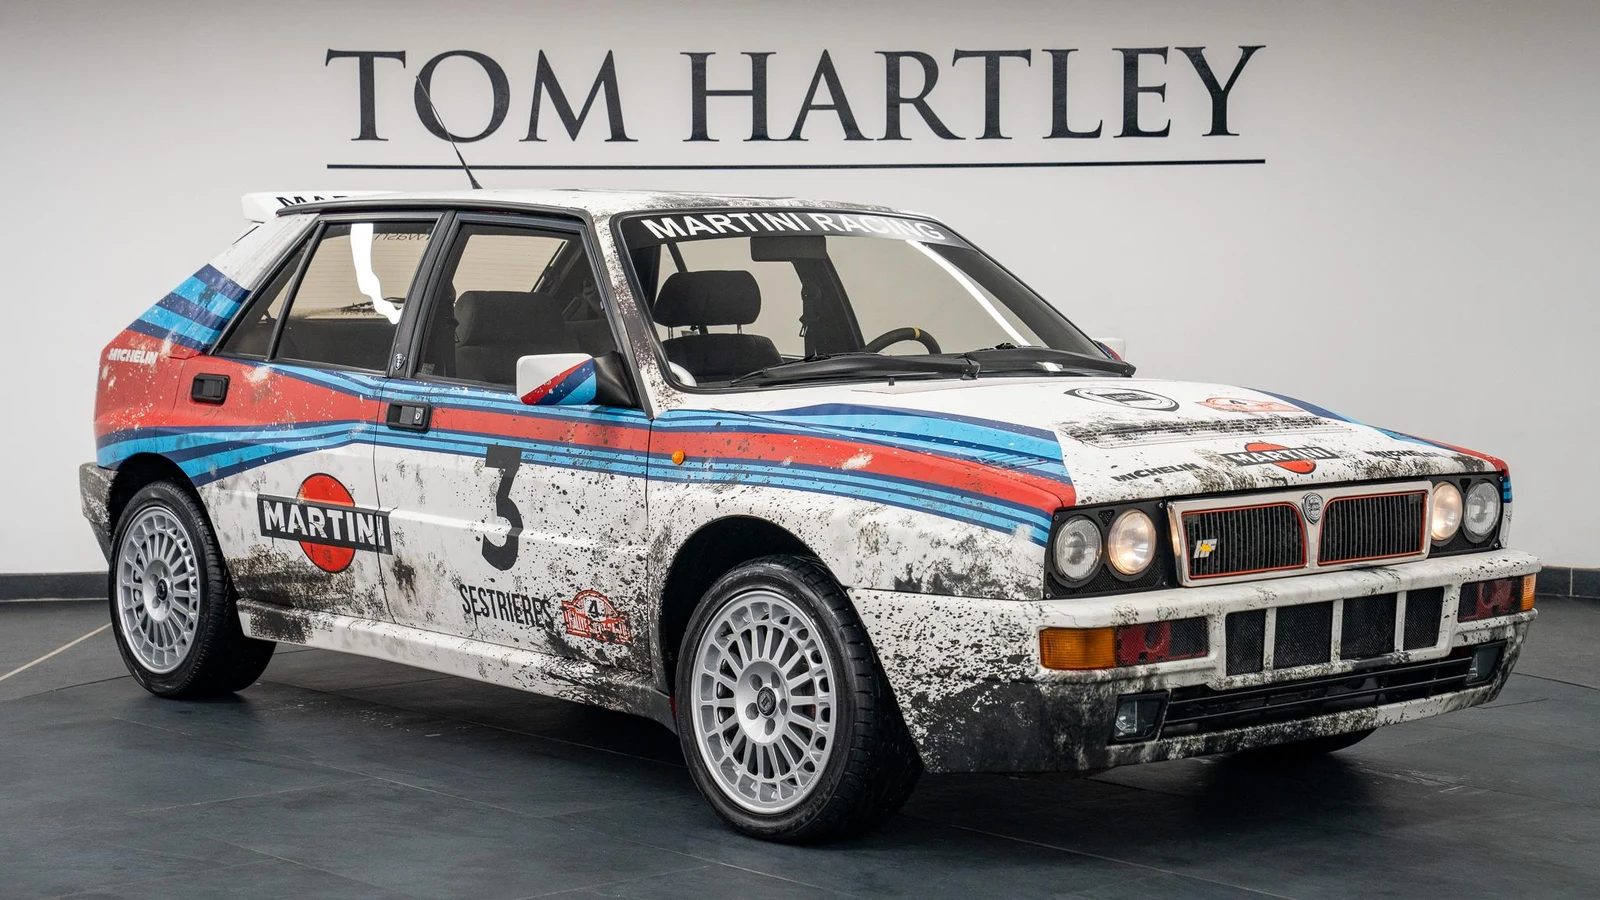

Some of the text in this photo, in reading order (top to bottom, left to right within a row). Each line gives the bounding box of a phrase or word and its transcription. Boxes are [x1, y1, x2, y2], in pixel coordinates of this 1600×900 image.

[325, 45, 1266, 142] TOM HARTLEY
[641, 212, 946, 240] MARTINI RACING
[108, 348, 159, 365] MICHELIN
[1226, 448, 1332, 463] MARTINI
[1110, 463, 1202, 481] MICHELIN
[482, 444, 524, 571] 3
[262, 500, 386, 547] MARTINI
[460, 584, 554, 631] SESTRIERES
[588, 600, 600, 618] 4
